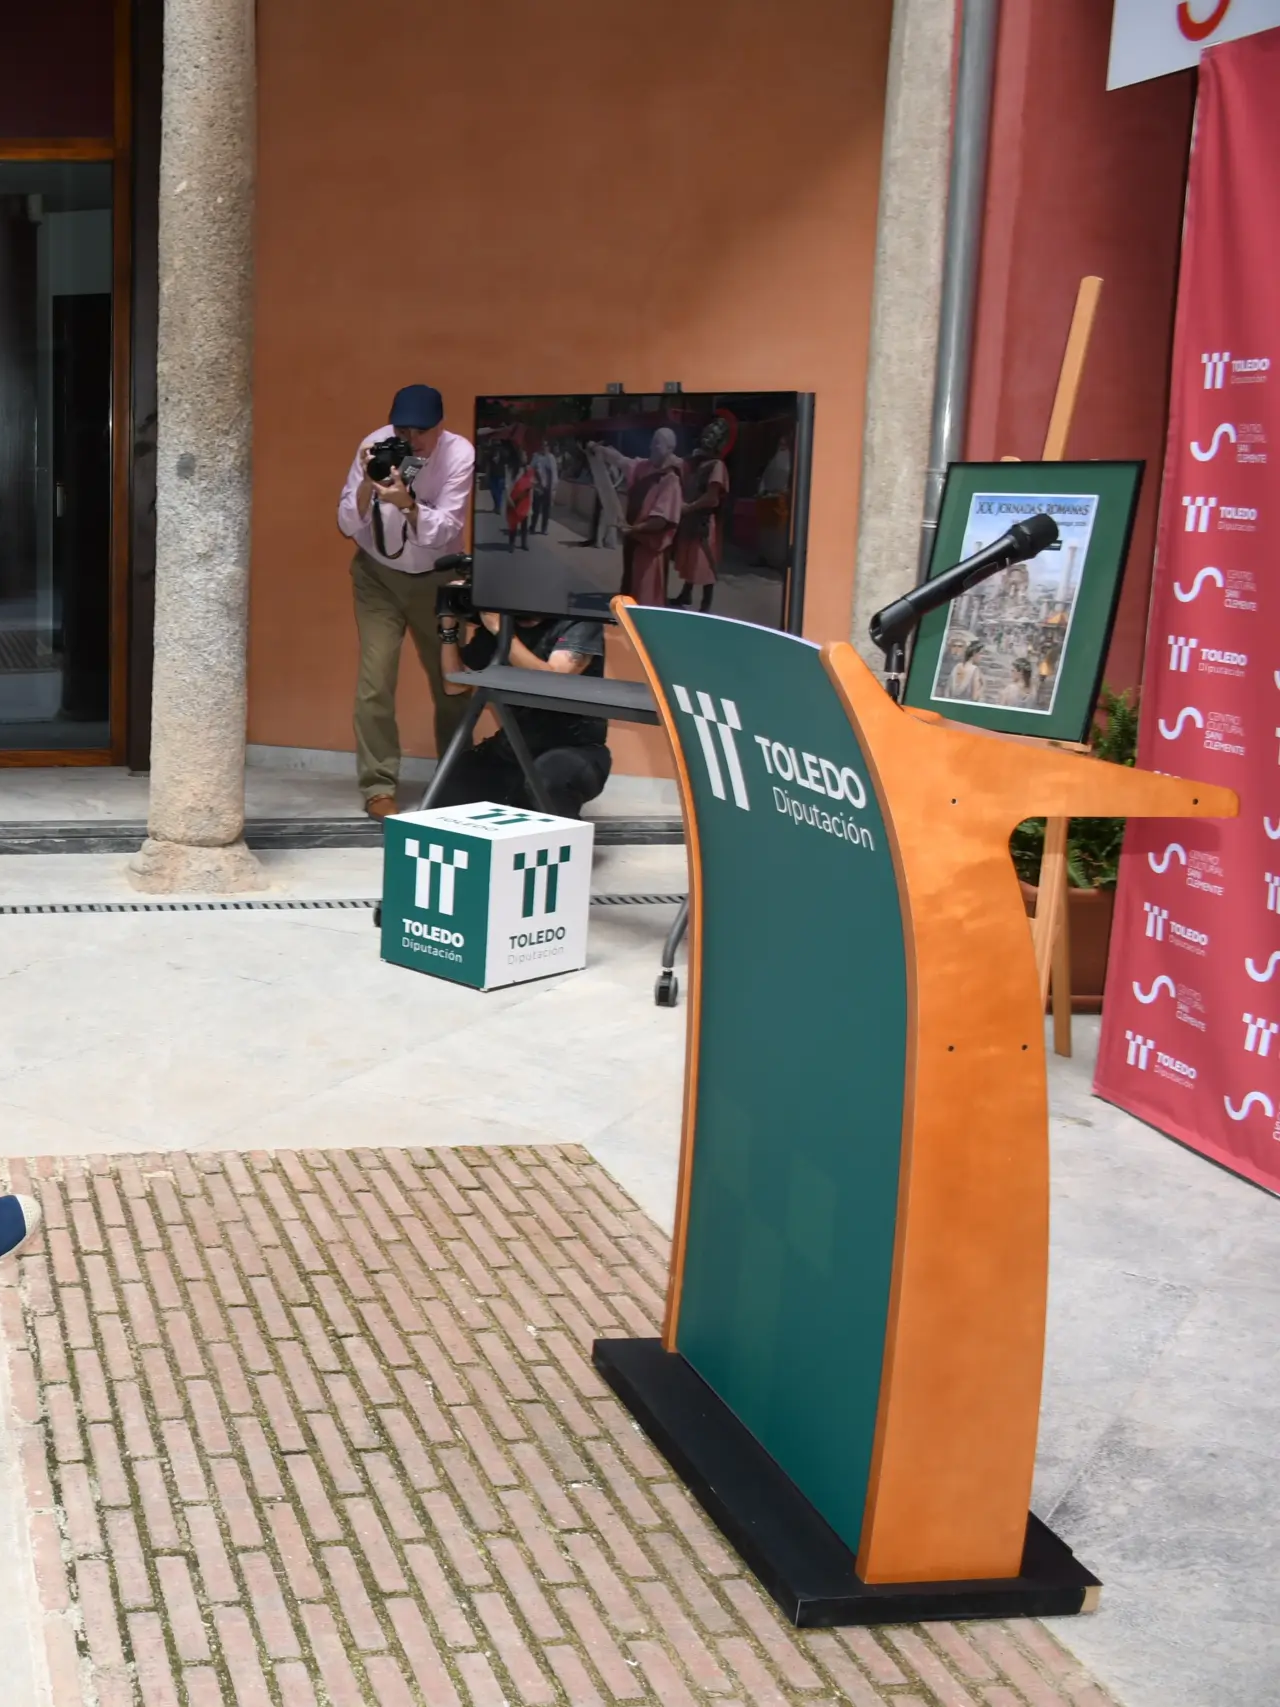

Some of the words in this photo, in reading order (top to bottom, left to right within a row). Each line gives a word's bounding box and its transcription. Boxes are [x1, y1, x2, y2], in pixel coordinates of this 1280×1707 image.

[1046, 502, 1089, 516] ROMANAS
[1219, 506, 1258, 521] TOLEDO
[1200, 648, 1248, 666] TOLEDO
[1207, 711, 1241, 725] CENTRO
[1204, 730, 1223, 741] SAN
[1206, 721, 1245, 737] CULTURAL
[1203, 740, 1246, 756] CLEMENTE
[753, 734, 867, 809] TOLEDO
[435, 816, 499, 831] TOLEDO
[772, 786, 875, 851] Diputación
[1189, 850, 1219, 865] CENTRO
[1188, 858, 1224, 877] CULTURAL
[1186, 877, 1224, 896] CLEMENTE
[402, 918, 465, 948] TOLEDO
[509, 926, 566, 949] TOLEDO
[1170, 921, 1209, 946] TOLEDO
[401, 936, 463, 963] Diputación
[507, 944, 564, 965] Diputación
[1156, 1052, 1197, 1080] TOLEDO
